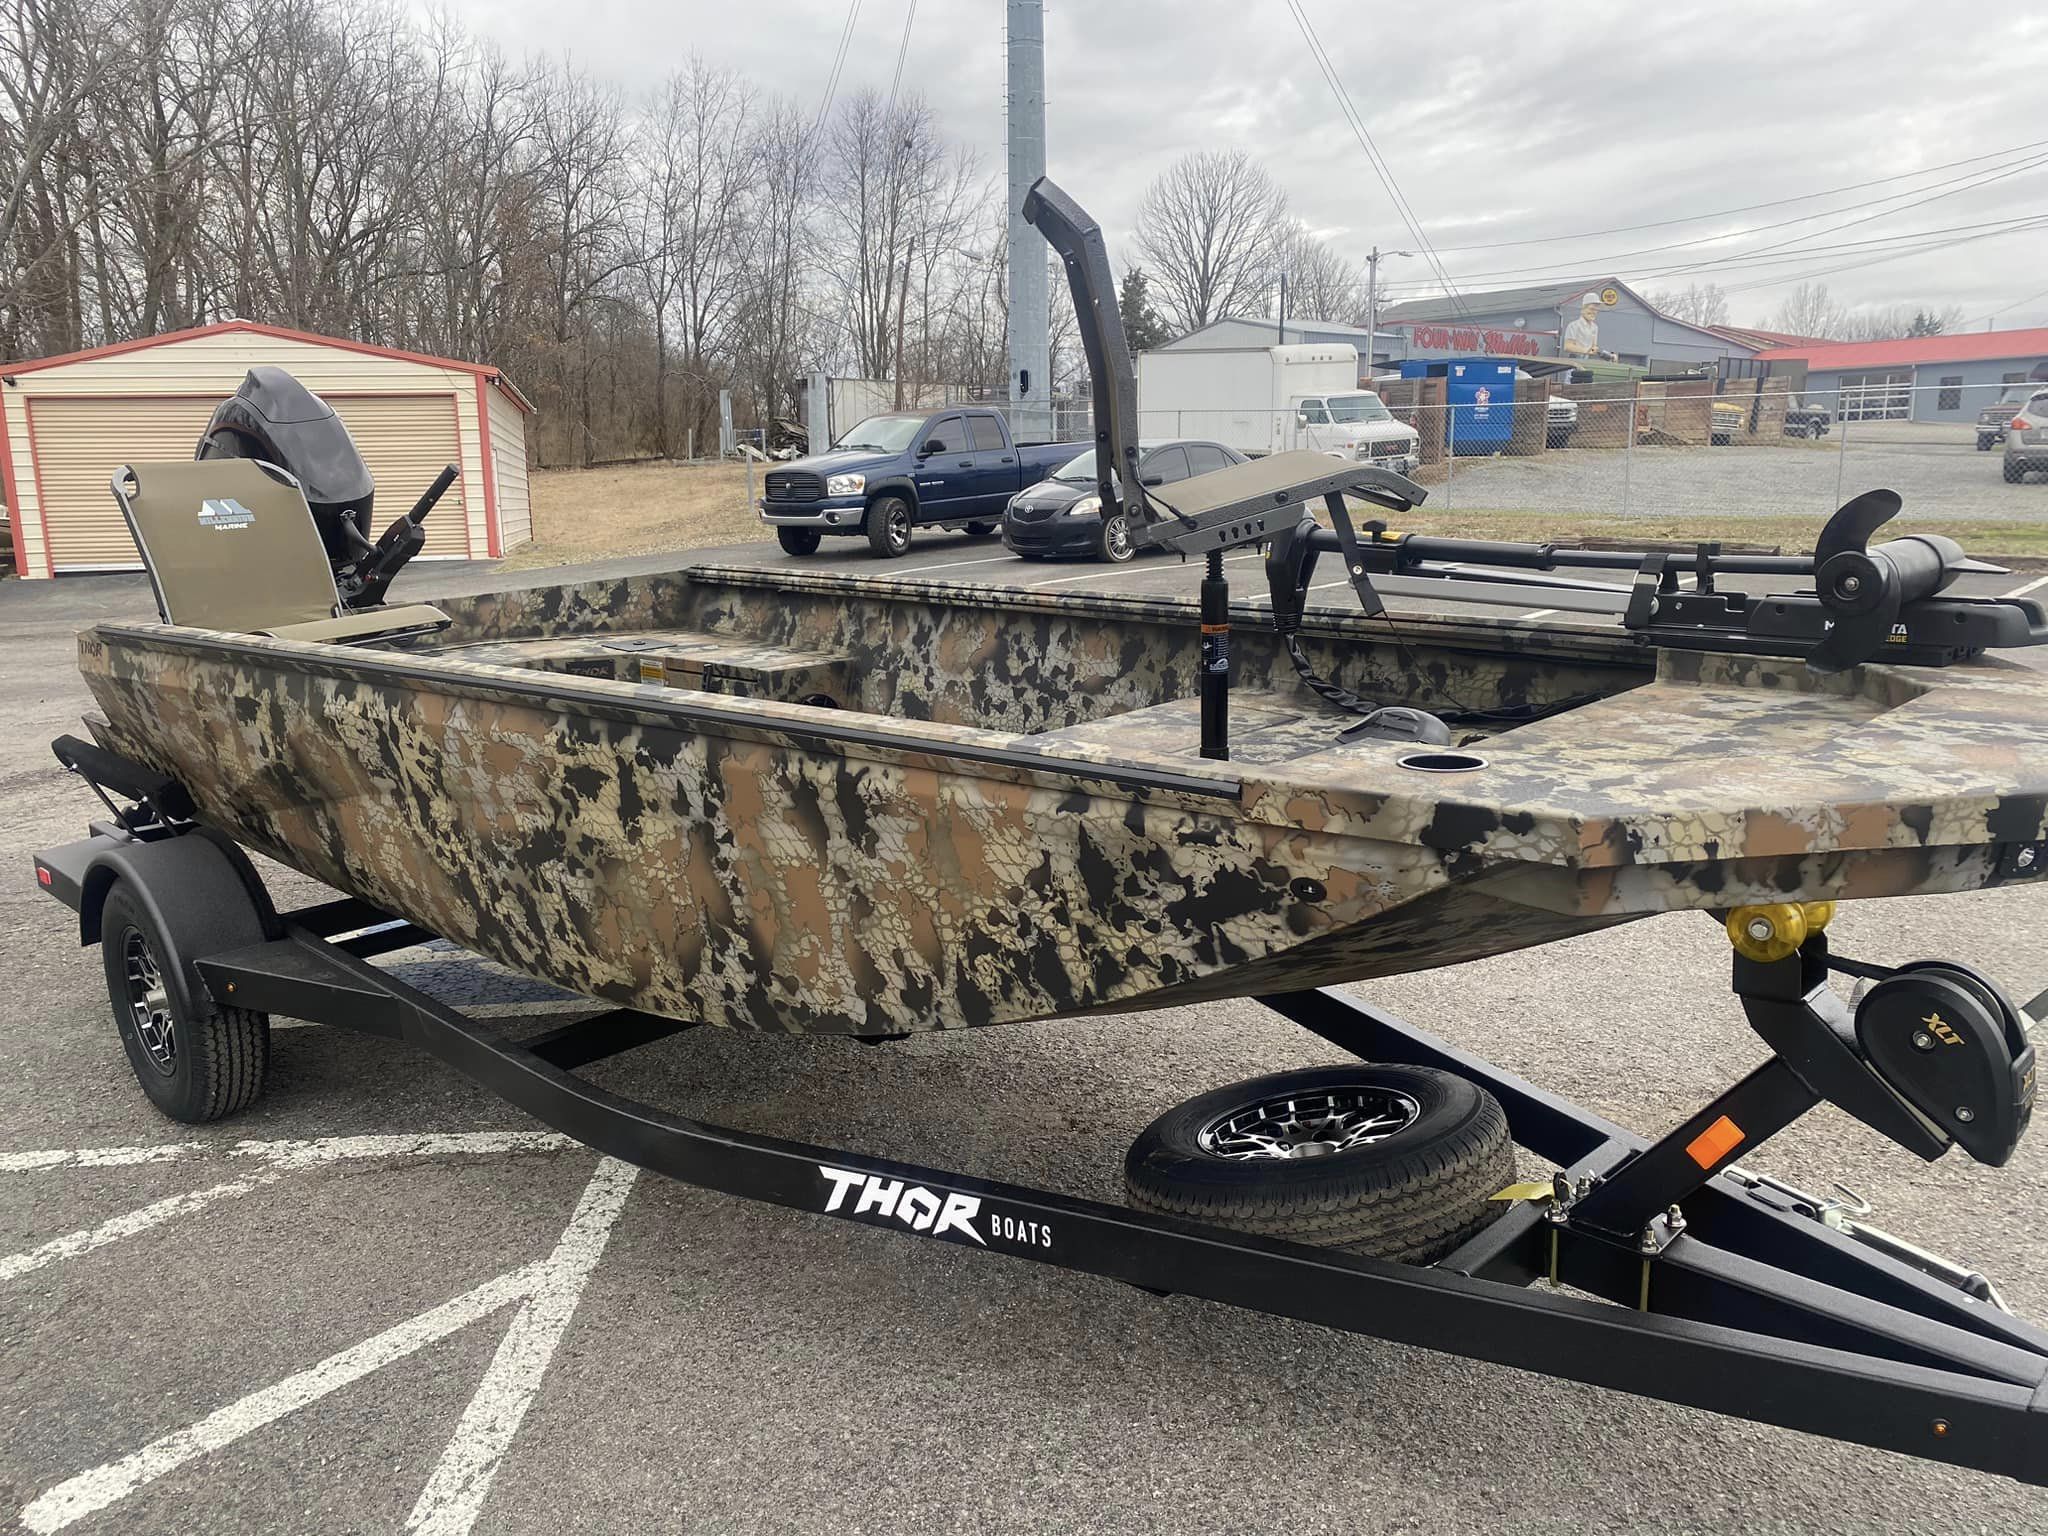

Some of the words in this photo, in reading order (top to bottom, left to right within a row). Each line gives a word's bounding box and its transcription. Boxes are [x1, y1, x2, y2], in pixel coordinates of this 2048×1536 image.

[214, 522, 249, 531] MARINE
[1921, 1012, 1966, 1045] XLT
[818, 1165, 987, 1246] THOR
[991, 1213, 1052, 1247] BOATS
